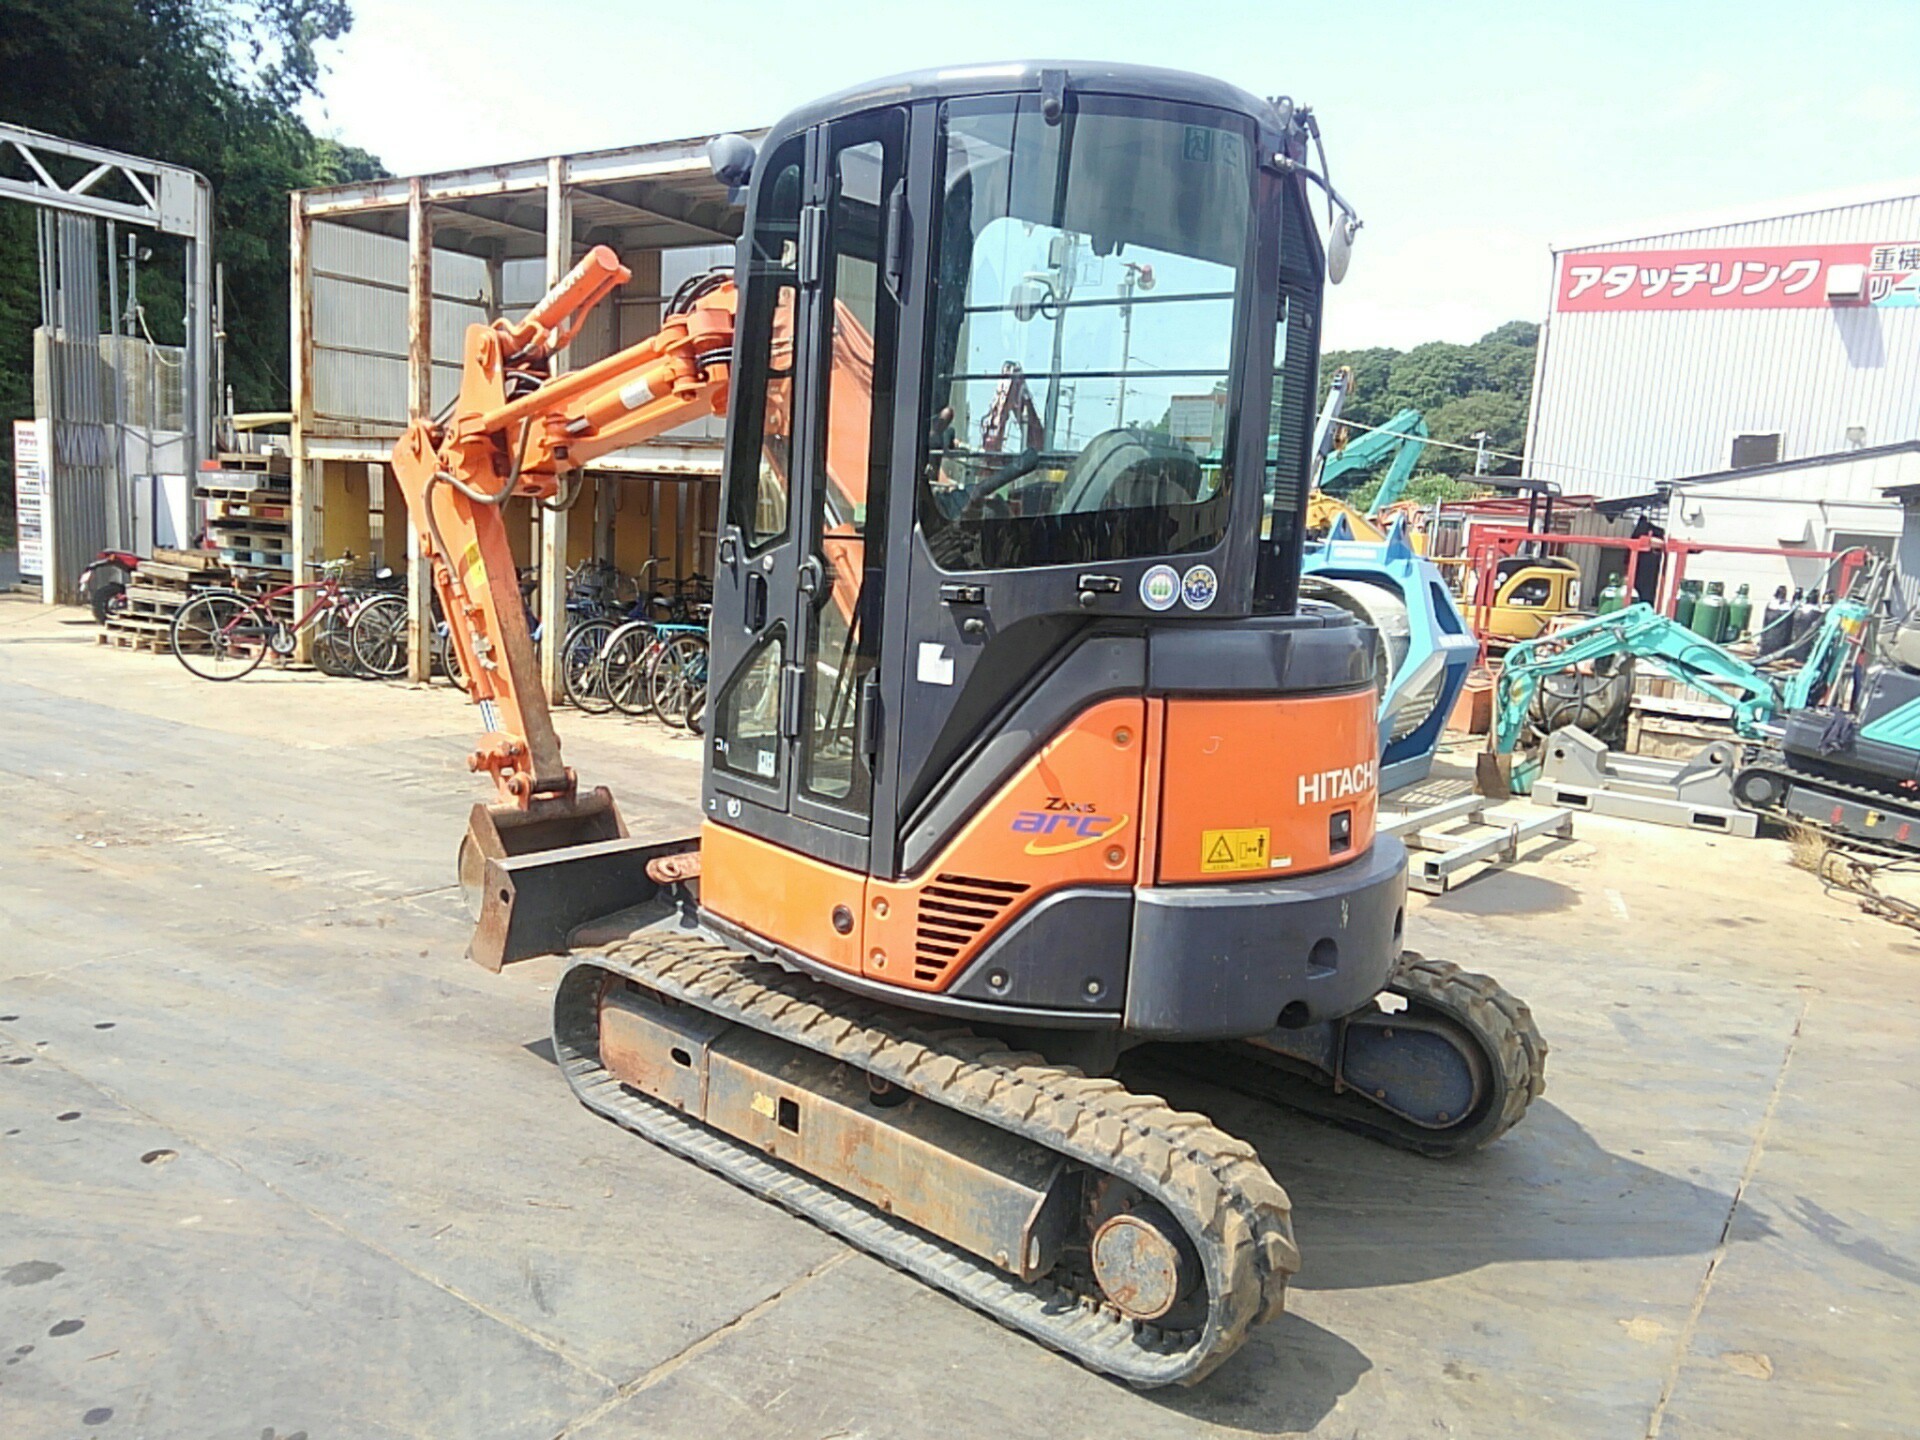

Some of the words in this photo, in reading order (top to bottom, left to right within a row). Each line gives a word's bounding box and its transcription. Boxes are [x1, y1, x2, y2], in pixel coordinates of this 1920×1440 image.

[1567, 259, 1822, 299] アタッチリンク
[1871, 278, 1920, 301] リー
[1298, 760, 1378, 806] HITACH
[1011, 811, 1113, 837] arc
